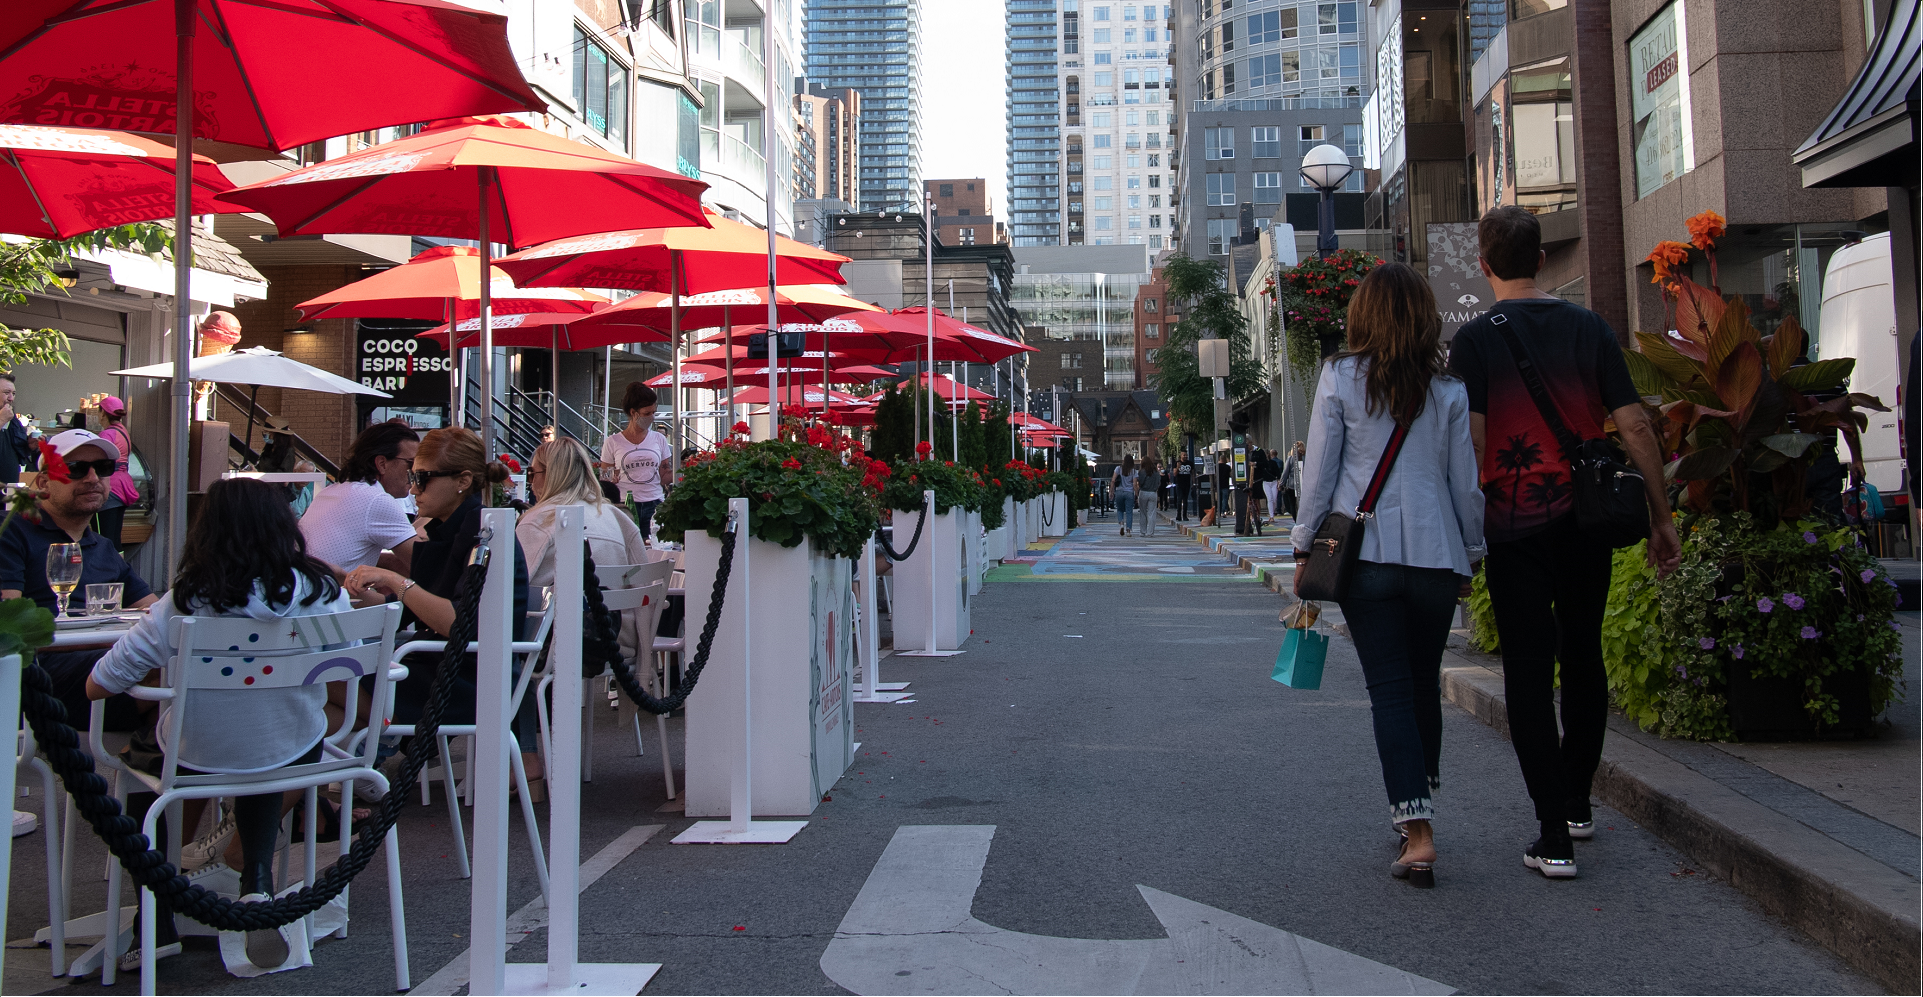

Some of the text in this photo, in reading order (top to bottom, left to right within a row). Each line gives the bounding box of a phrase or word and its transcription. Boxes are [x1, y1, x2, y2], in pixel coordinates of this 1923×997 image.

[1650, 57, 1675, 89] LEASED
[679, 155, 700, 181] BLYSS
[363, 339, 418, 355] COCO
[362, 357, 452, 372] ESPRESSO
